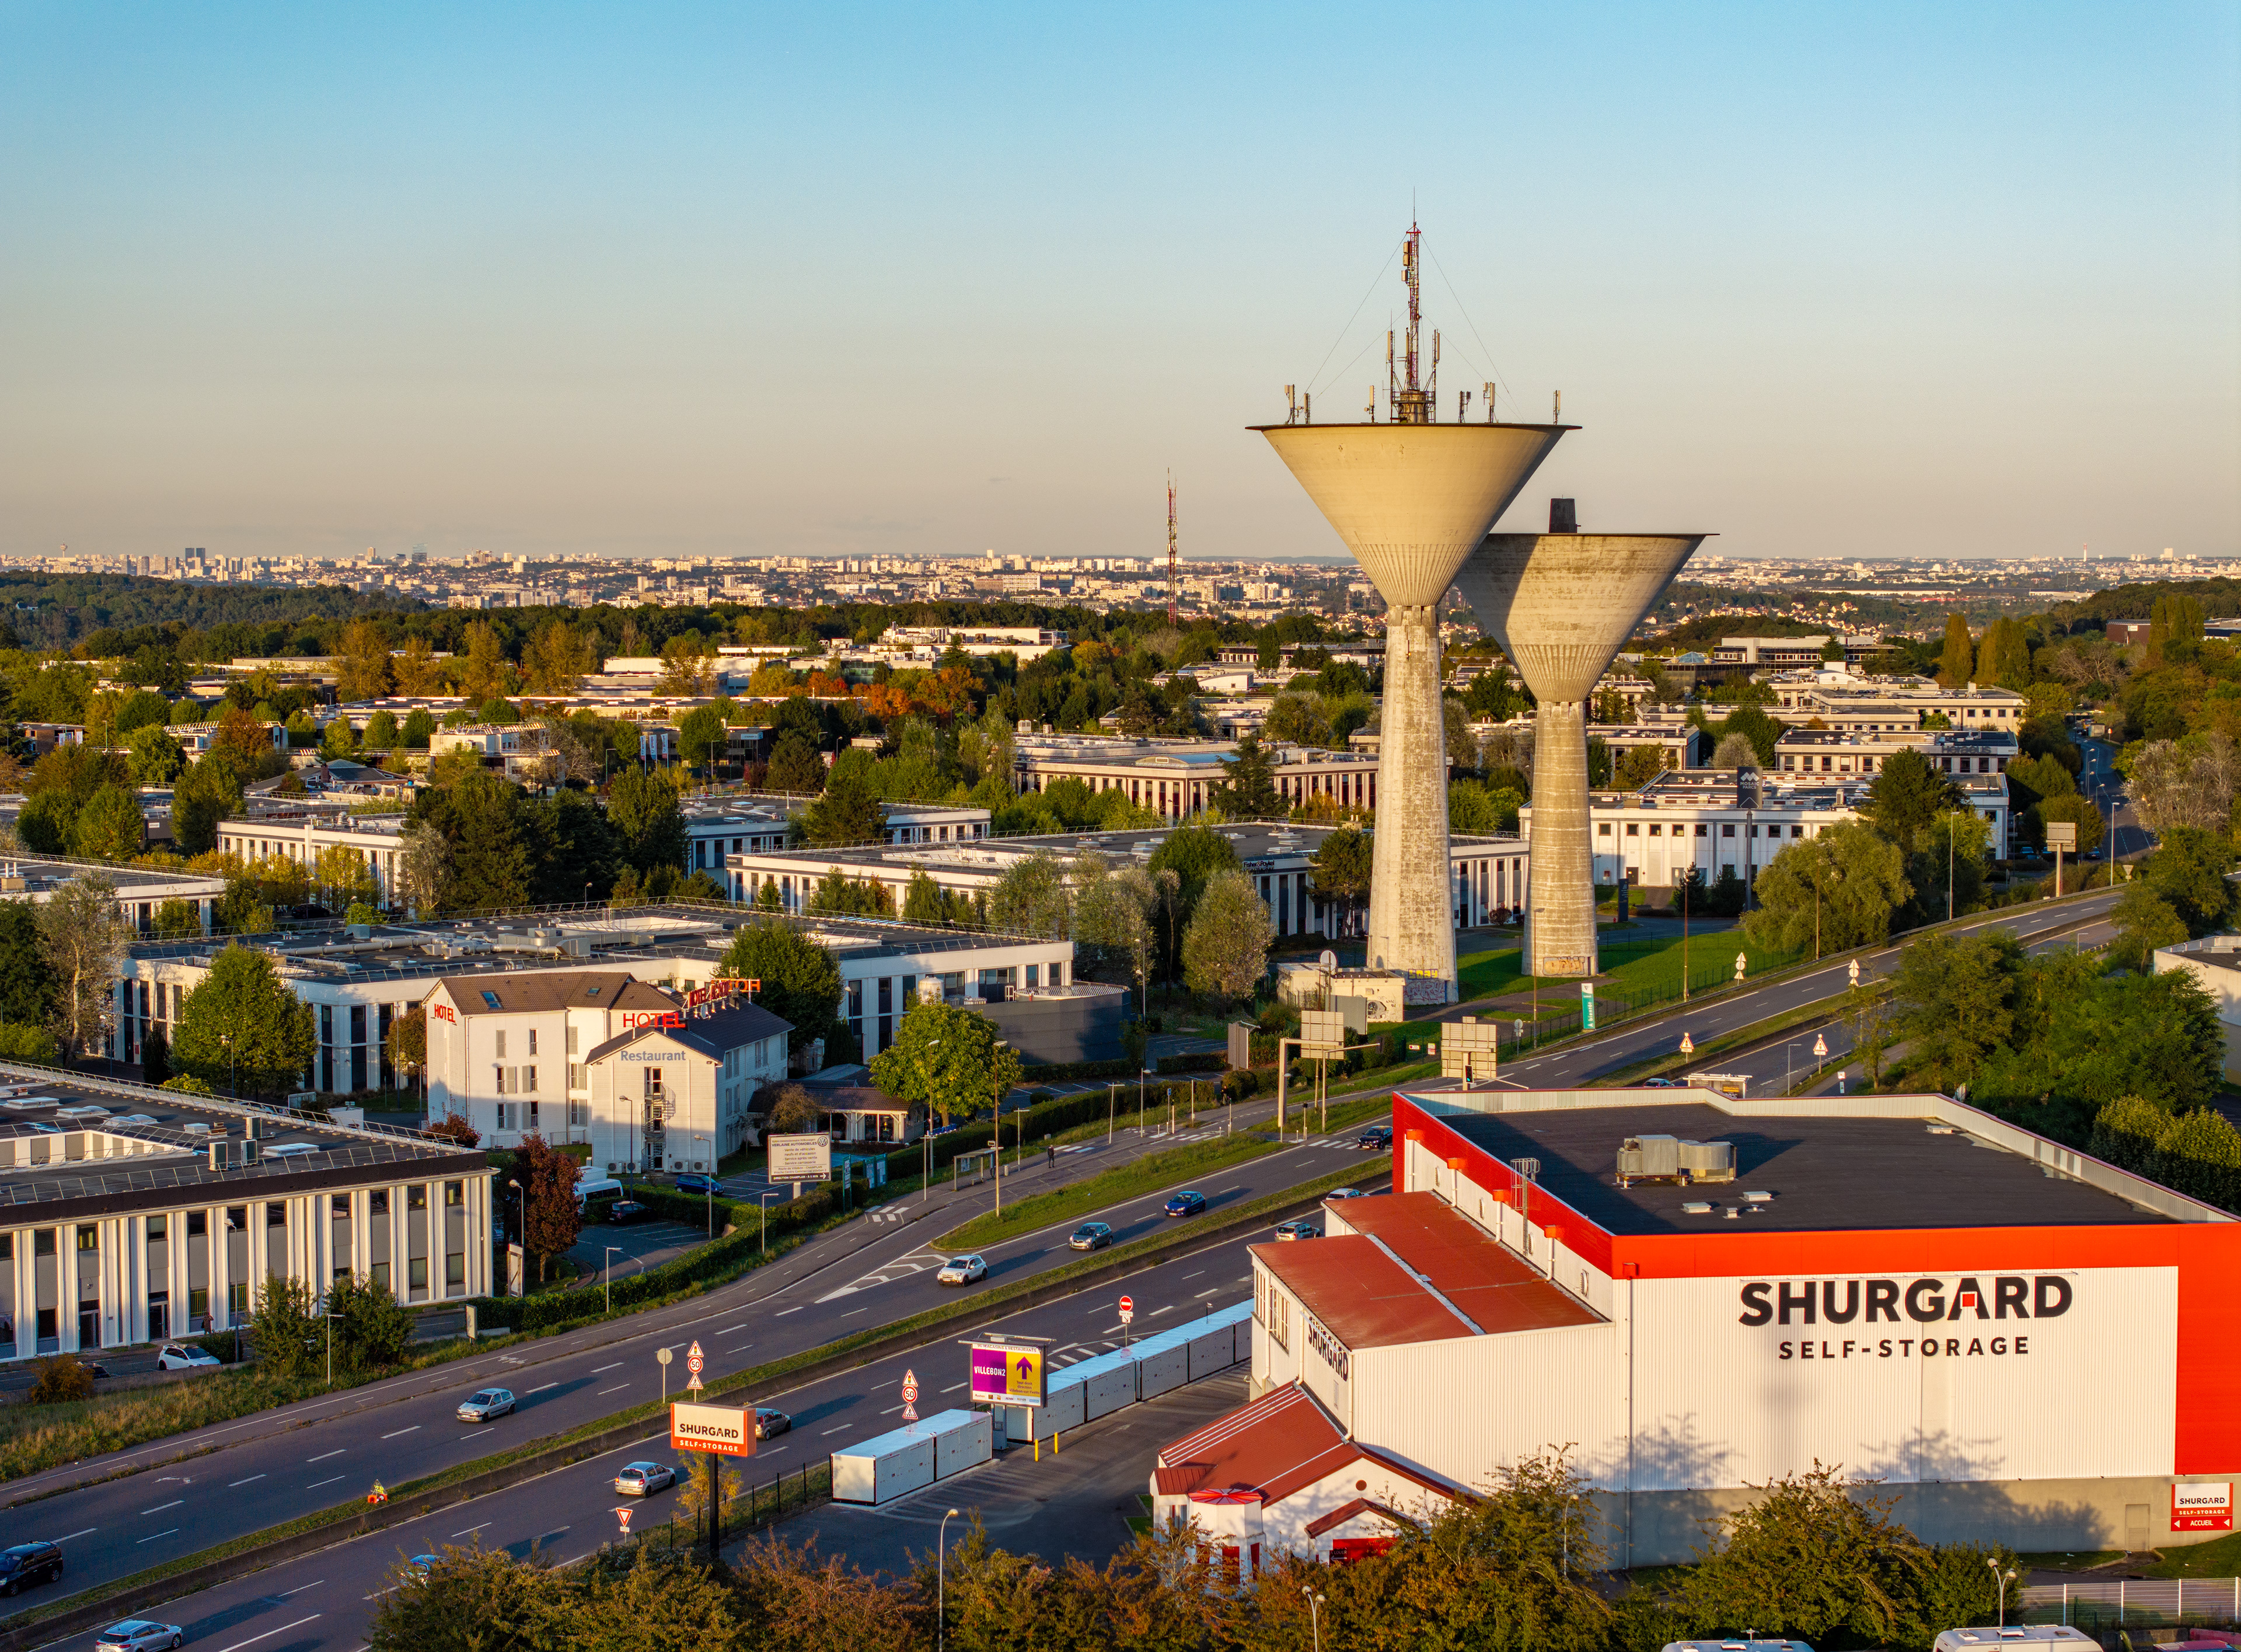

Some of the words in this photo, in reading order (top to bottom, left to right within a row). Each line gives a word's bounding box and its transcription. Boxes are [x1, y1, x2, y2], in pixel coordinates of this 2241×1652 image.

[434, 1003, 456, 1023] HOTEL
[623, 1012, 686, 1028] HOTEL
[621, 1050, 686, 1061] Restaurant
[1739, 1276, 2073, 1326] SHURGARD
[1308, 1316, 1348, 1382] SHURGARD
[1779, 1336, 2028, 1360] SELF-STORAGE
[974, 1366, 1006, 1376] VILLEBON2
[680, 1423, 738, 1438] SHURGARD
[680, 1440, 738, 1452] SELF-STORAGE
